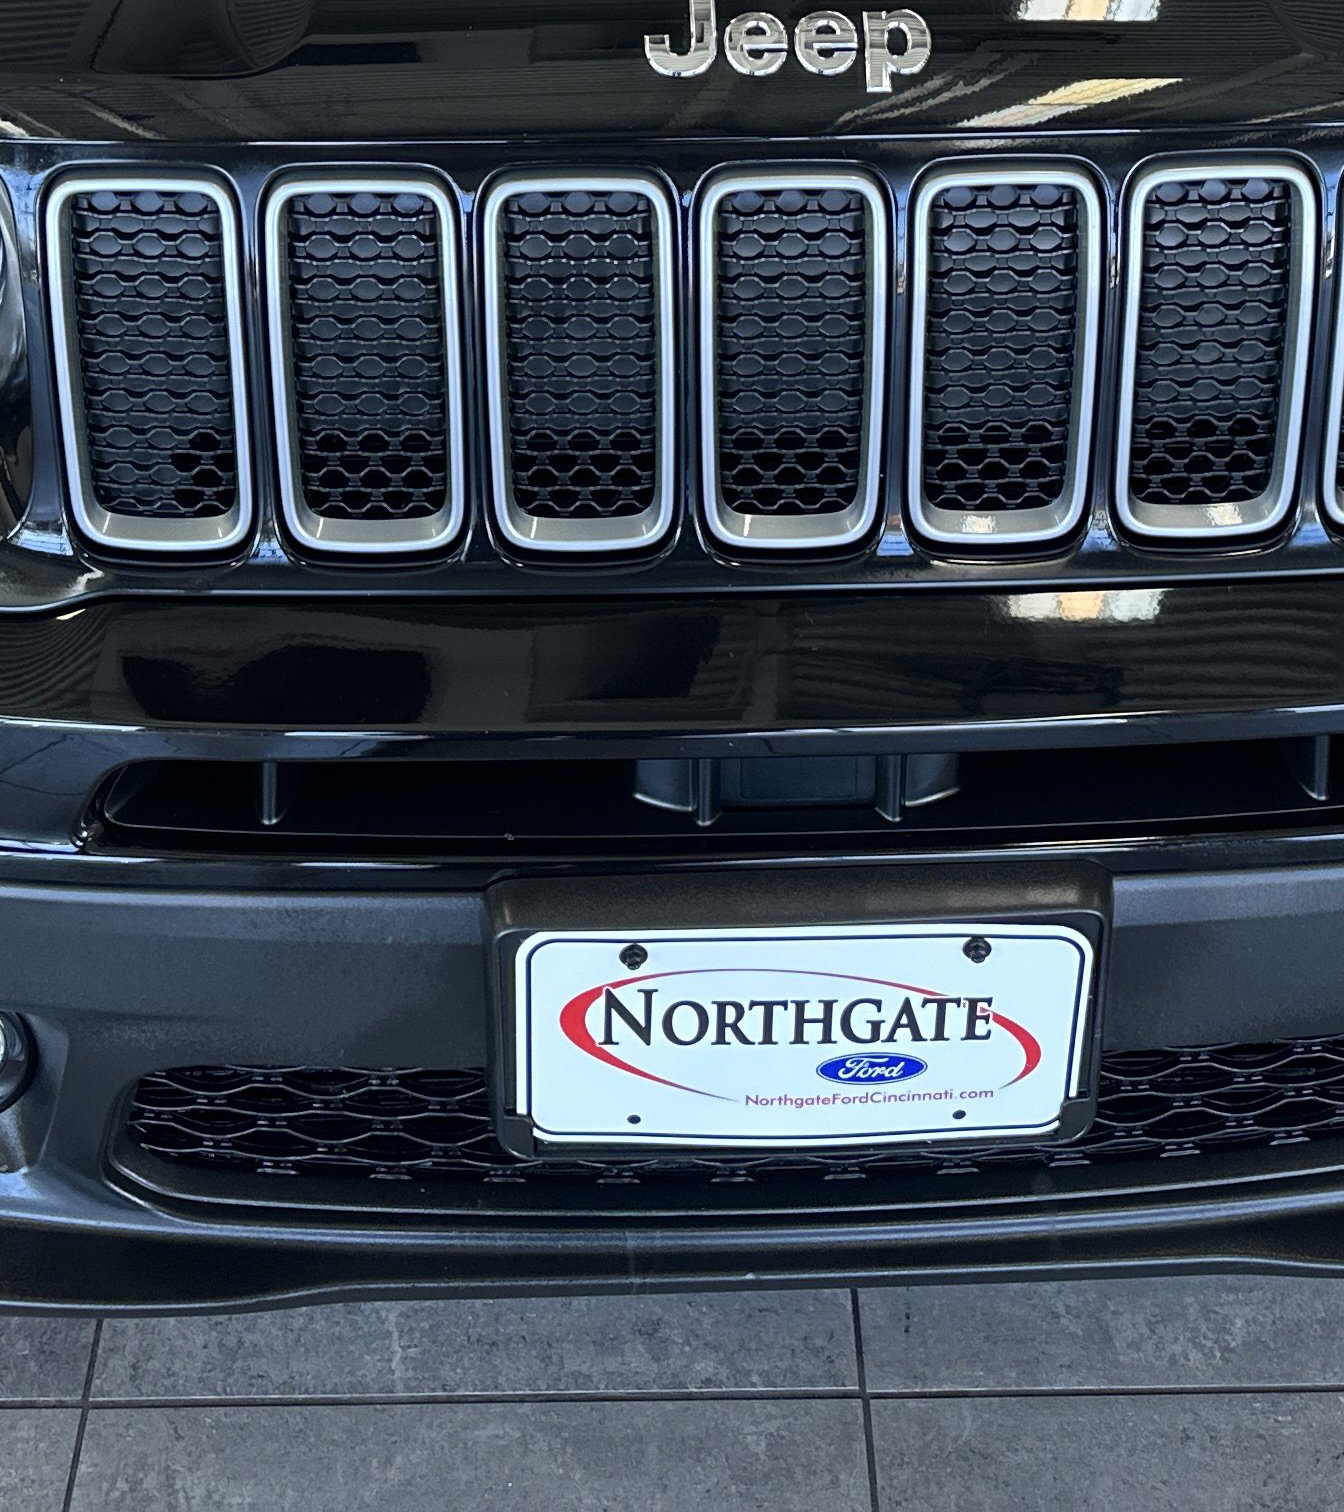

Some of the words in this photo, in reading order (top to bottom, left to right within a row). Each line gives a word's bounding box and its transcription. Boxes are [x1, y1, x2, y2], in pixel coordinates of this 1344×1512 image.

[598, 987, 994, 1047] NORTHGATE
[837, 1057, 905, 1079] Ford
[745, 1088, 994, 1109] NorthgateFordCincinnati.com
